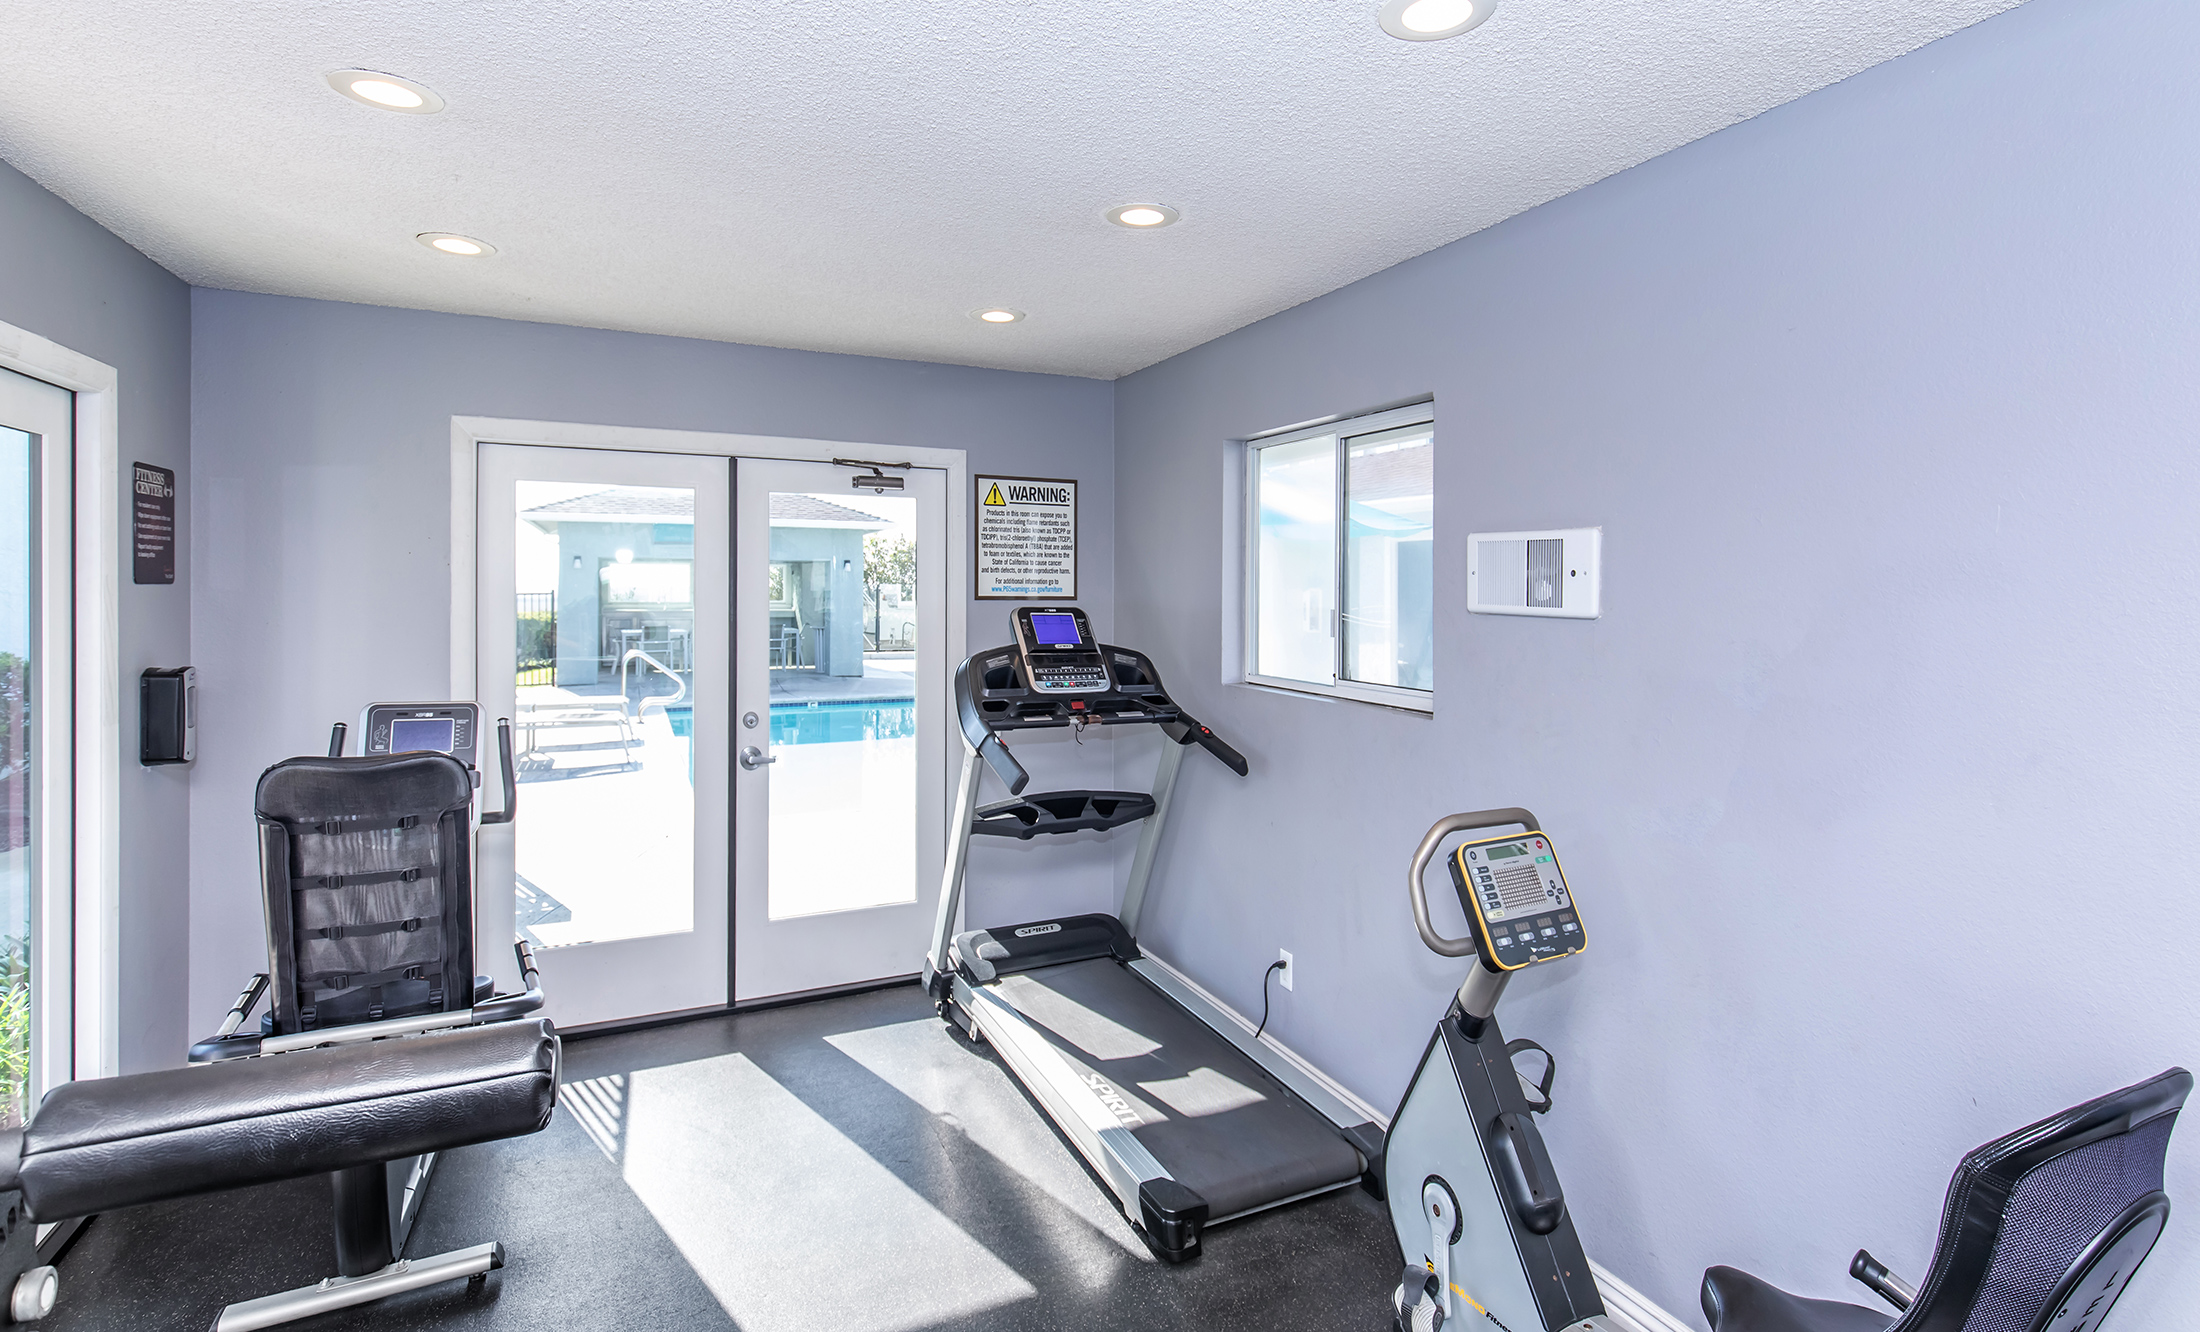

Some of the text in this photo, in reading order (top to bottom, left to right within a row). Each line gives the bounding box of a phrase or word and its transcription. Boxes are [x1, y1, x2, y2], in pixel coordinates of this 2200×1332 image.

[136, 468, 165, 485] FITNESS
[136, 481, 164, 498] CENTER
[1008, 485, 1070, 503] WARNING:
[1006, 518, 1026, 526] including
[1020, 925, 1055, 935] SPIRIT
[1080, 1072, 1146, 1125] SPIRIT
